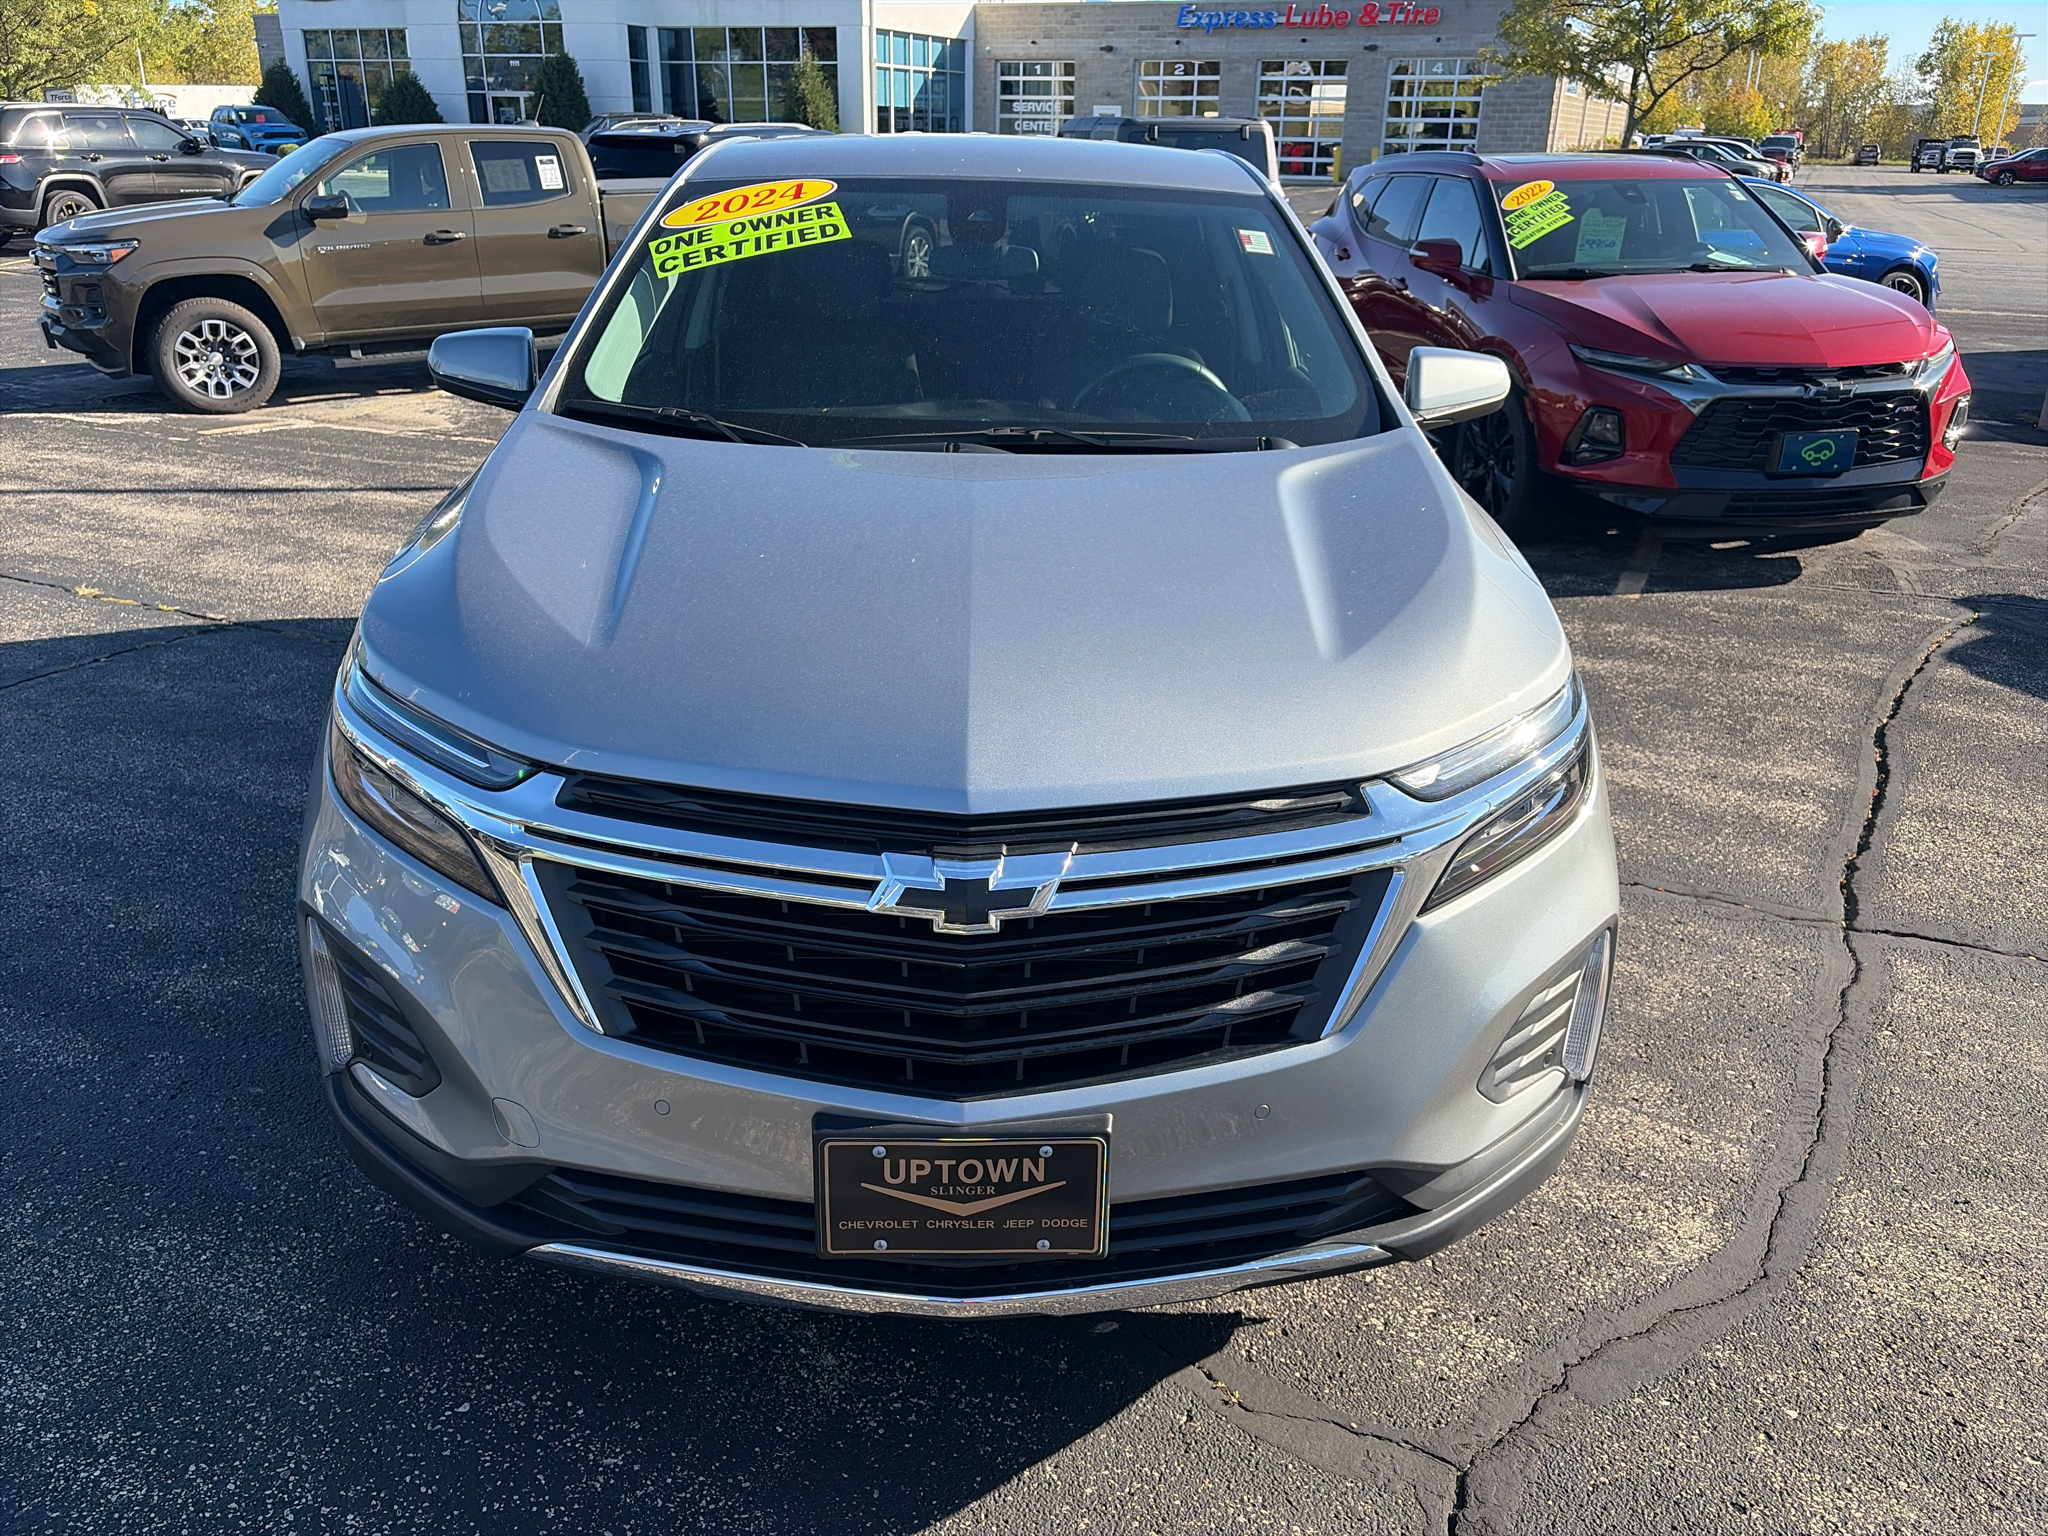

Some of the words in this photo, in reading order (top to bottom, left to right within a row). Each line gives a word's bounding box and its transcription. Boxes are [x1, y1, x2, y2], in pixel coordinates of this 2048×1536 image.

[1176, 4, 1278, 34] Express
[1285, 4, 1350, 27] Lube
[1357, 2, 1380, 26] &
[1387, 1, 1440, 25] Tire
[1034, 64, 1041, 75] 1
[1173, 63, 1185, 75] 2
[1431, 62, 1444, 74] 4
[1012, 101, 1062, 112] SERVICE
[1014, 120, 1060, 131] CENTER
[694, 182, 808, 223] 2024
[1511, 183, 1547, 206] 2022
[1509, 209, 1530, 223] ONE
[1530, 193, 1564, 211] OWNER
[1510, 203, 1565, 235] CERTIFIED
[655, 227, 714, 255] ONE
[729, 205, 837, 236] OWNER
[1513, 226, 1546, 247] NAVIGATION
[1546, 214, 1569, 228] SYSTEM
[317, 243, 371, 252] COLORADO
[658, 223, 841, 274] CERTIFIED
[883, 1158, 1045, 1185] UPTOWN
[930, 1185, 996, 1196] SLINGER
[838, 1220, 919, 1230] CHEVROLET
[926, 1219, 995, 1229] CHRYSLER
[1003, 1219, 1035, 1229] JEEP
[1041, 1218, 1088, 1228] DODGE
